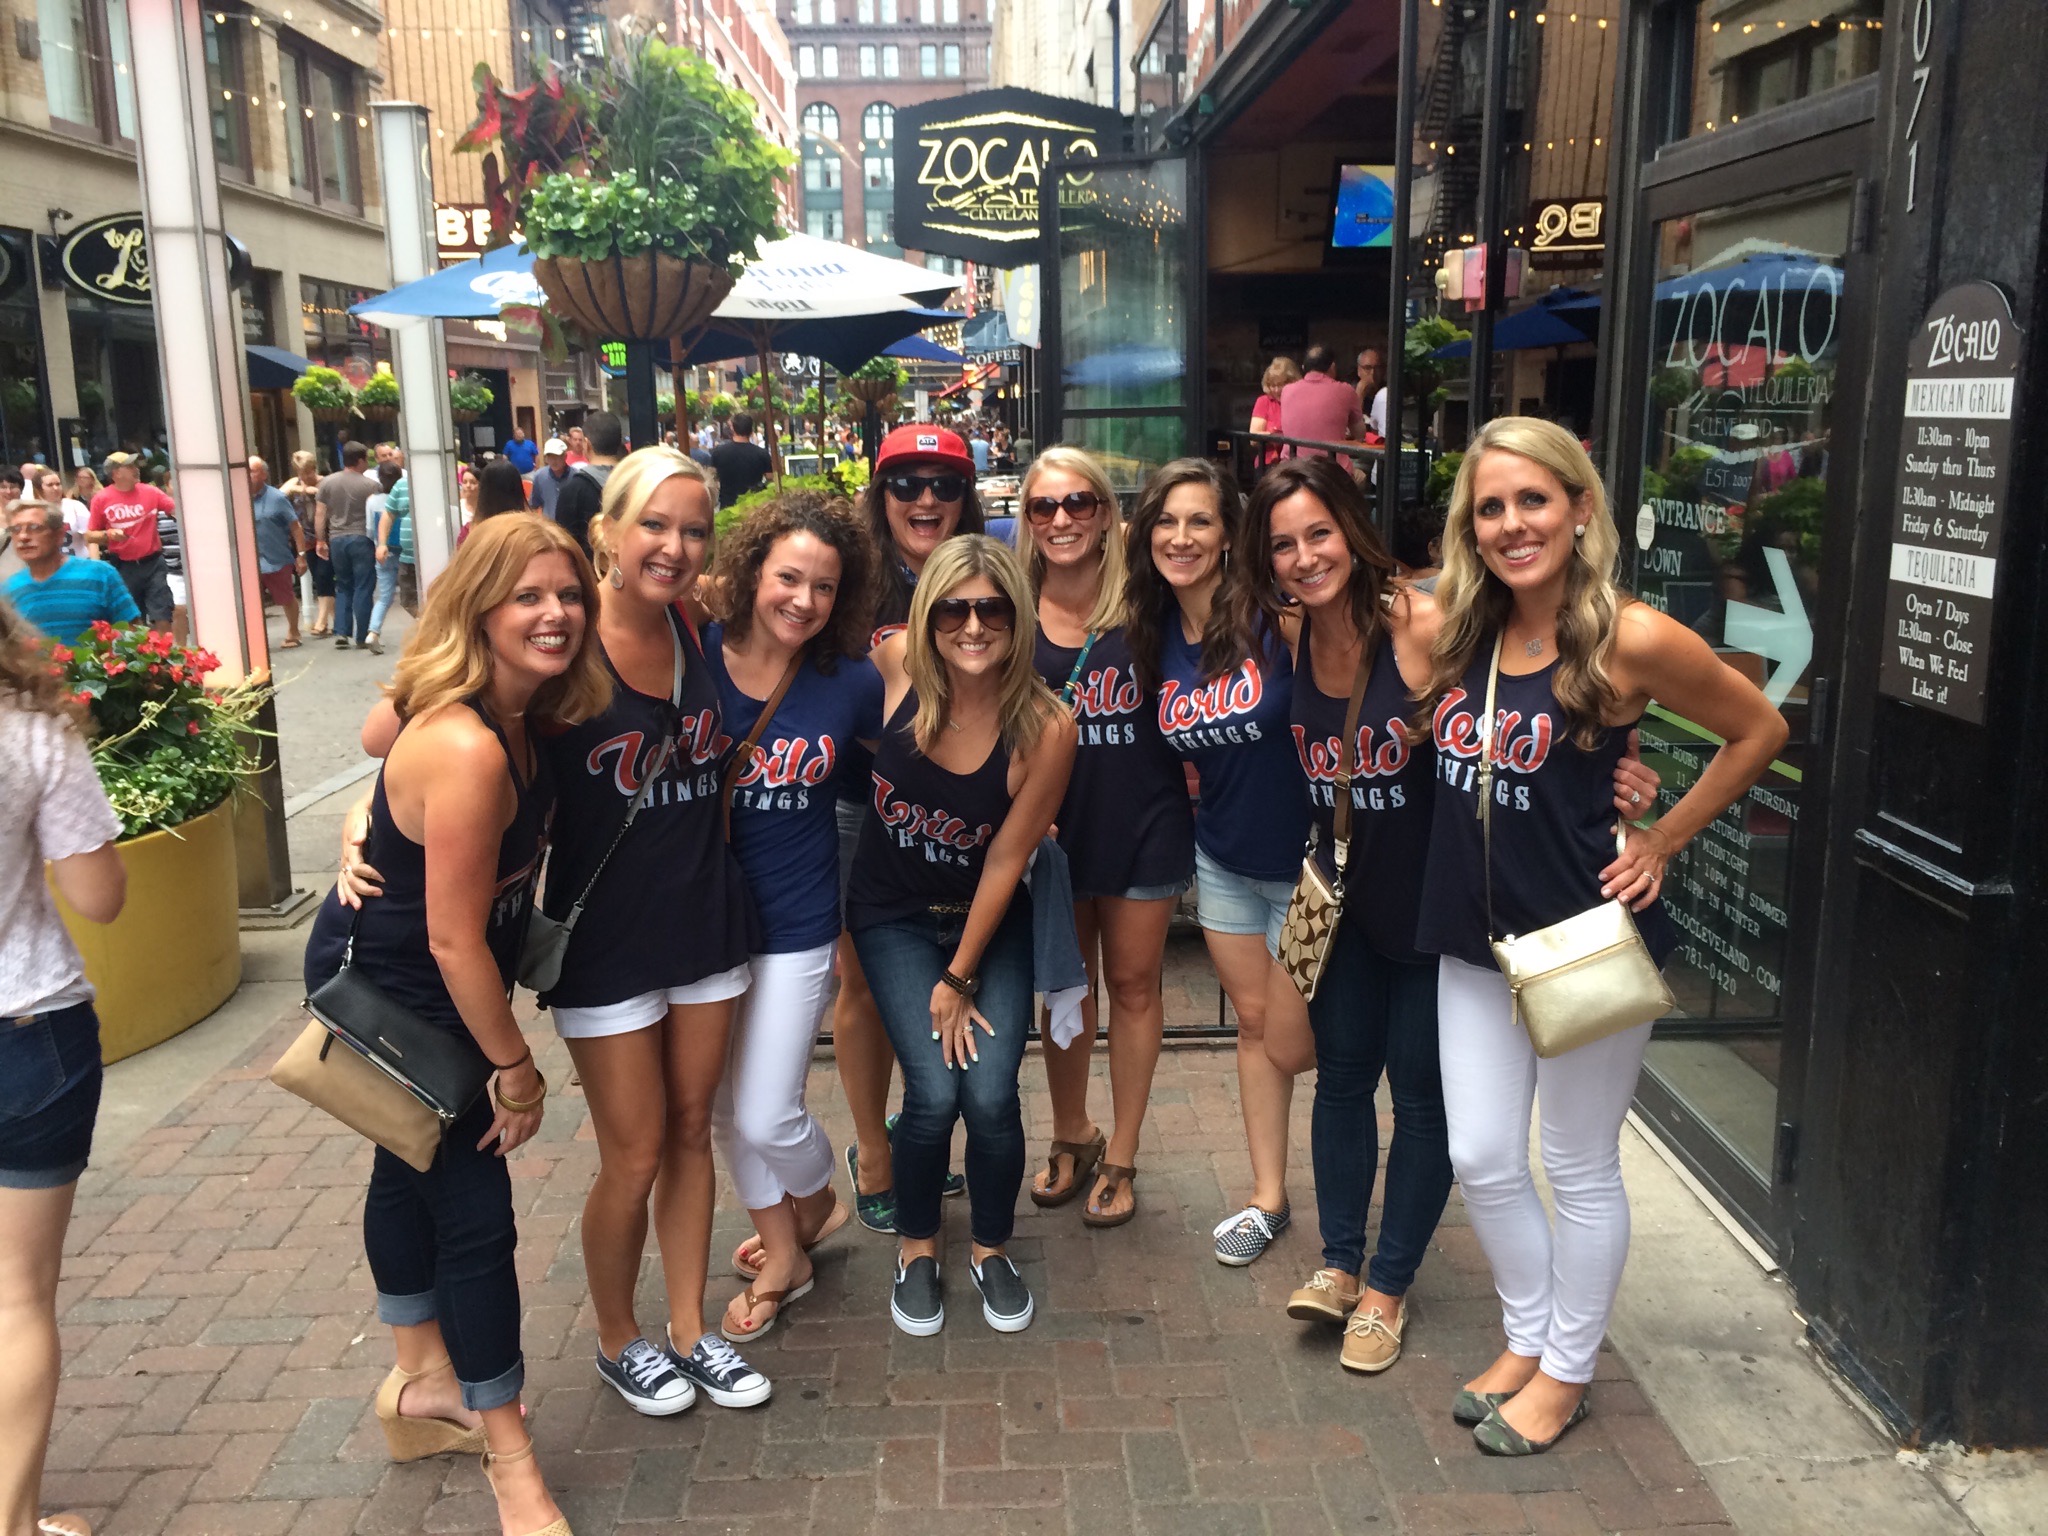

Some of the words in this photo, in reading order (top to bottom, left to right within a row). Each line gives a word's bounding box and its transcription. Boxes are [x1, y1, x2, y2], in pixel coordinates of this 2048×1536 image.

[969, 208, 1039, 221] CLEVELAN
[1665, 264, 1838, 369] ZOCALO
[1910, 383, 1965, 413] MEXICAN
[1969, 382, 2006, 413] GRILL
[1701, 416, 1773, 438] CLEVEND
[1917, 426, 1953, 447] 11:30am
[1964, 427, 1990, 455] 10pm
[1904, 453, 1939, 481] Sunday
[1942, 454, 1962, 477] thru
[1967, 457, 1996, 479] Thurs
[103, 503, 146, 523] Coke
[1902, 486, 1937, 508] 11:30am
[1948, 490, 1995, 519] Midnight
[1902, 513, 1931, 541] Friday
[1933, 517, 1943, 537] &
[1946, 518, 1990, 550] Saturday
[1907, 549, 1977, 589] TEQUILERIA
[1906, 593, 1933, 620] Open
[1935, 599, 1944, 618] 7
[1945, 601, 1970, 630] Days
[1898, 618, 1932, 644] 11:30am
[1943, 629, 1974, 655] Close
[1899, 645, 1925, 671] When
[1929, 653, 1945, 676] We
[1947, 658, 1969, 683] Feel
[1157, 658, 1263, 736] Wild
[1911, 676, 1934, 701] Like
[1936, 685, 1948, 705] it!
[1077, 723, 1136, 746] INGS
[1165, 720, 1263, 752] THINGS
[1672, 745, 1699, 770] HOURS
[627, 770, 718, 809] HINGS
[1308, 783, 1406, 811] THNGS
[1436, 752, 1531, 811] THIGS
[730, 788, 809, 811] INGS
[1748, 785, 1800, 820] THURSDAY
[883, 822, 970, 867] THNGS
[1706, 818, 1751, 850] ATURDAY
[1708, 891, 1720, 911] IN
[1724, 902, 1761, 939] WINTER
[1732, 881, 1745, 900] IN
[1749, 892, 1788, 929] SUMMER
